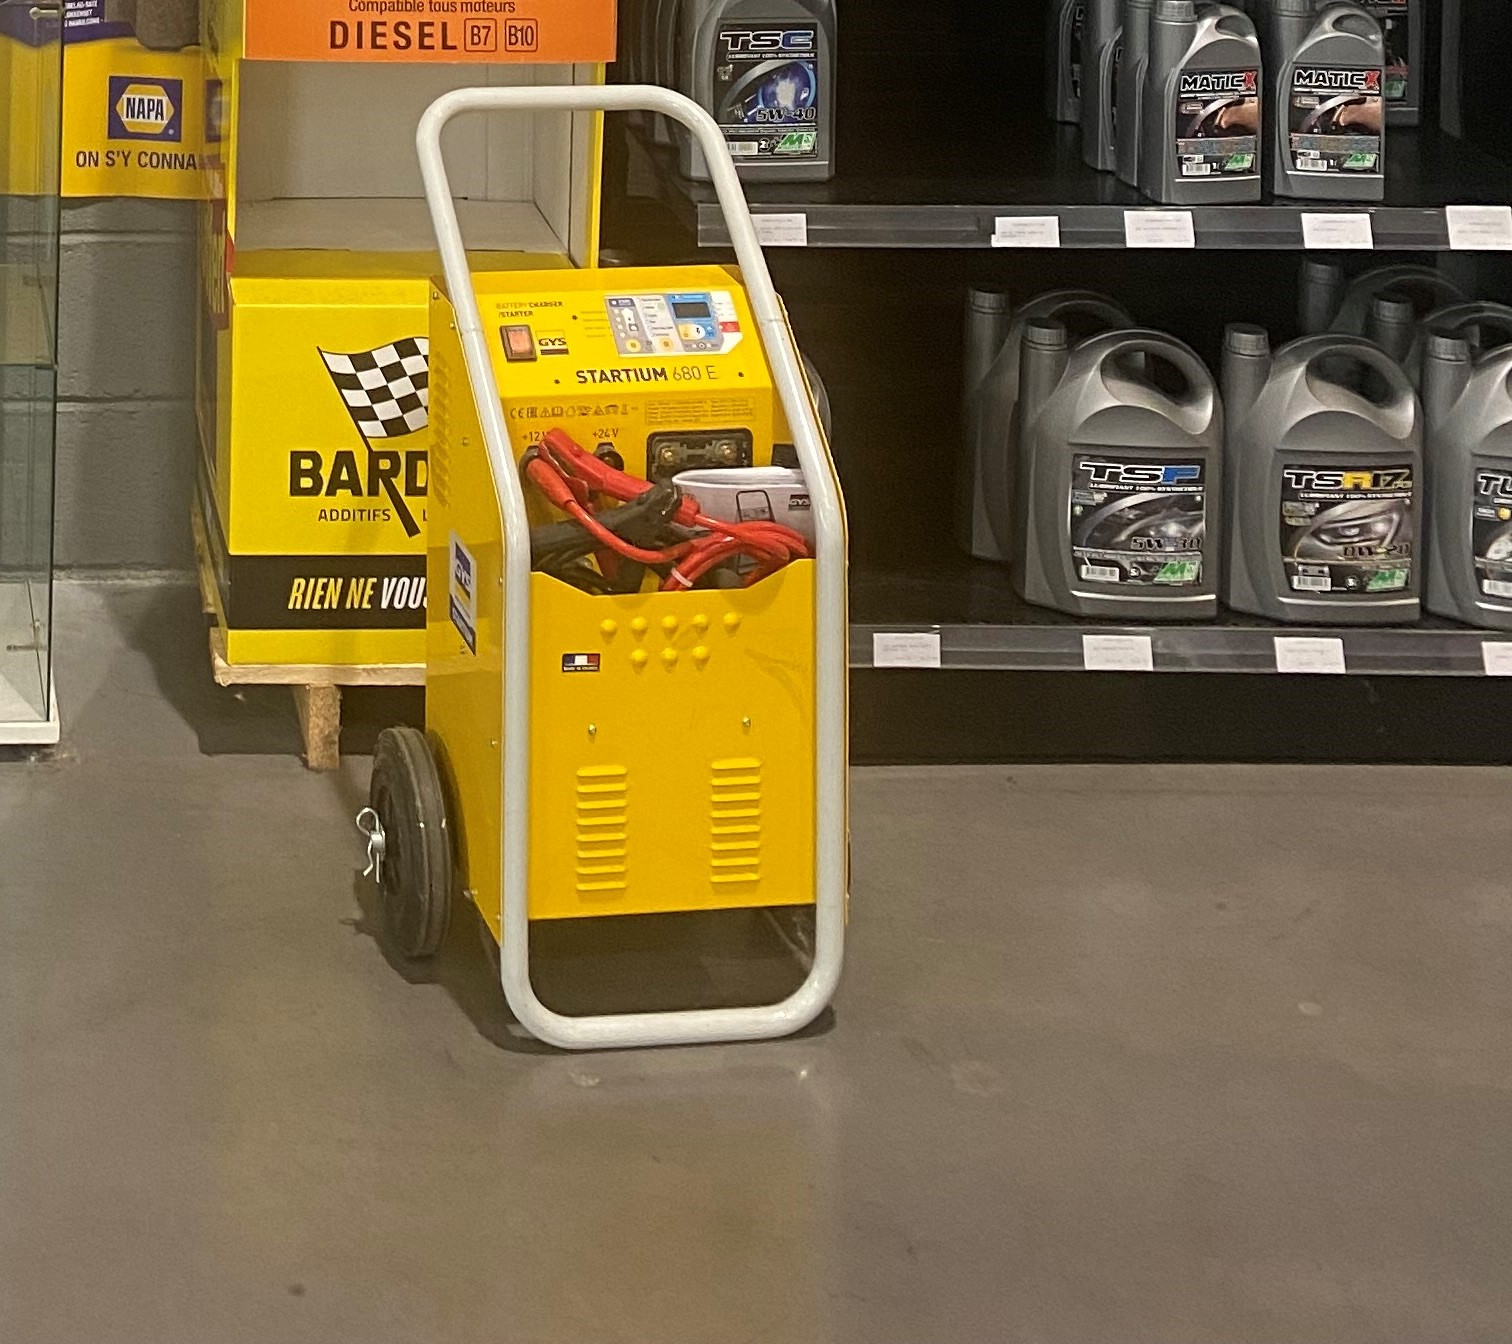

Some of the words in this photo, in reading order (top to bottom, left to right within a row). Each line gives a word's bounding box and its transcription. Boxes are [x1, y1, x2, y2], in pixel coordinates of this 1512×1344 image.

[460, 0, 516, 14] moteurs
[330, 20, 458, 51] DIESEL
[470, 23, 492, 48] B7
[507, 24, 535, 49] B10
[1180, 70, 1258, 92] MATICX
[1293, 68, 1381, 90] MATICX
[124, 95, 165, 122] NAPA
[756, 106, 817, 123] 5W-40
[75, 150, 99, 169] ON
[105, 149, 132, 168] S'Y
[137, 150, 198, 171] CONNA
[538, 337, 567, 348] GYS
[576, 367, 669, 385] STARTIUM
[672, 365, 702, 382] 680
[707, 365, 719, 380] E
[289, 450, 429, 498] BARD
[318, 509, 392, 523] ADDITIFS
[287, 577, 344, 610] RIEN
[345, 577, 378, 610] NE
[380, 577, 428, 610] VOU
